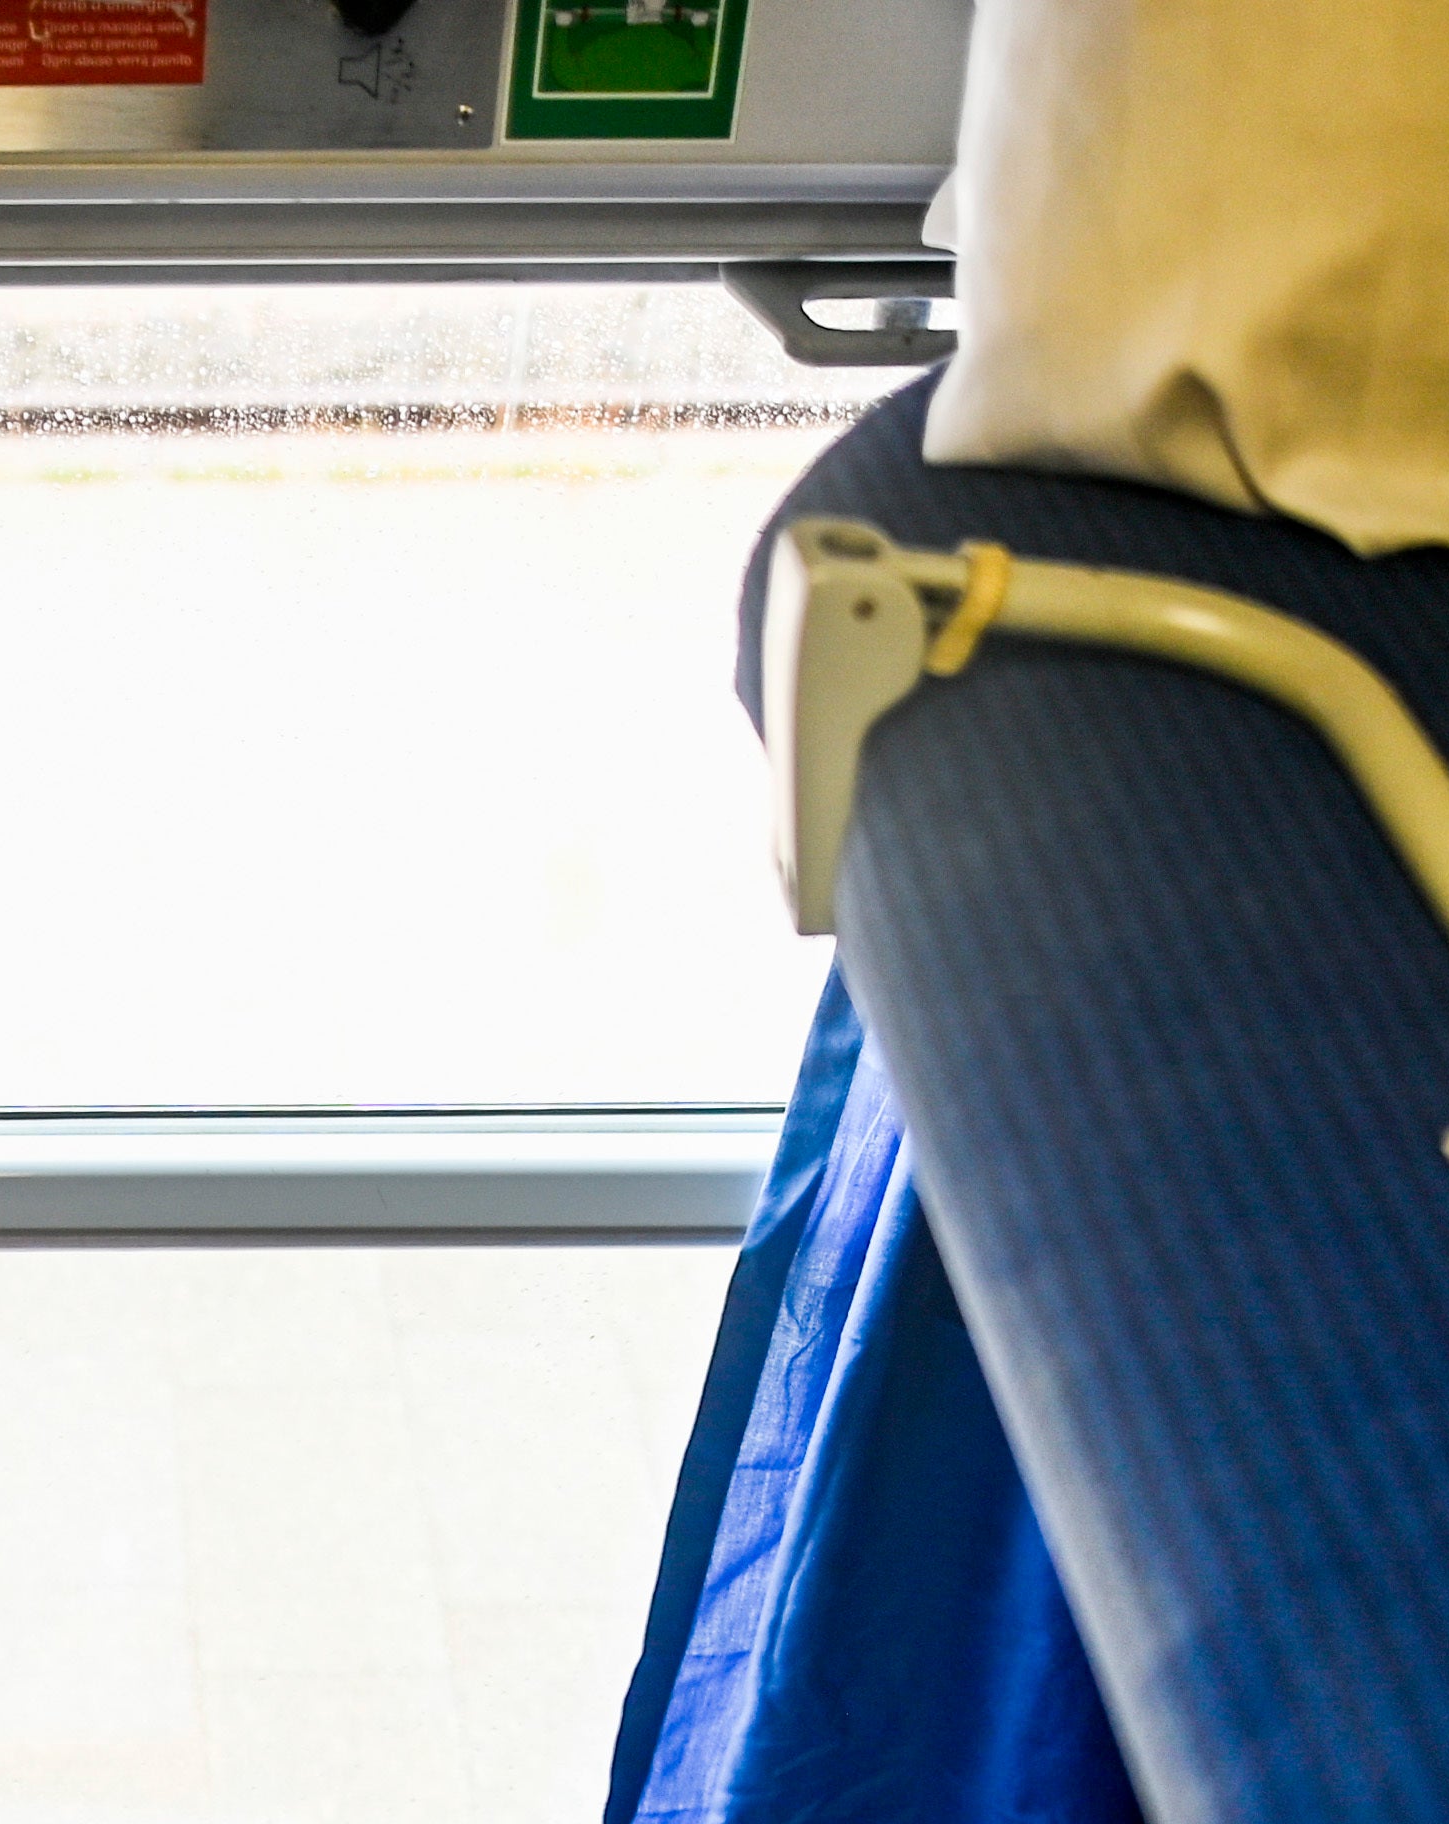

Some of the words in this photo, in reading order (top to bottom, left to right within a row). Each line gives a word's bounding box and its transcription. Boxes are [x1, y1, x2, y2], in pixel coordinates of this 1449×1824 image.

[82, 21, 95, 34] la
[57, 38, 87, 50] caso
[90, 36, 102, 50] di
[106, 37, 158, 52] pericolo
[42, 53, 71, 68] Ogni
[74, 54, 113, 67] abuso
[152, 52, 193, 68] punito
